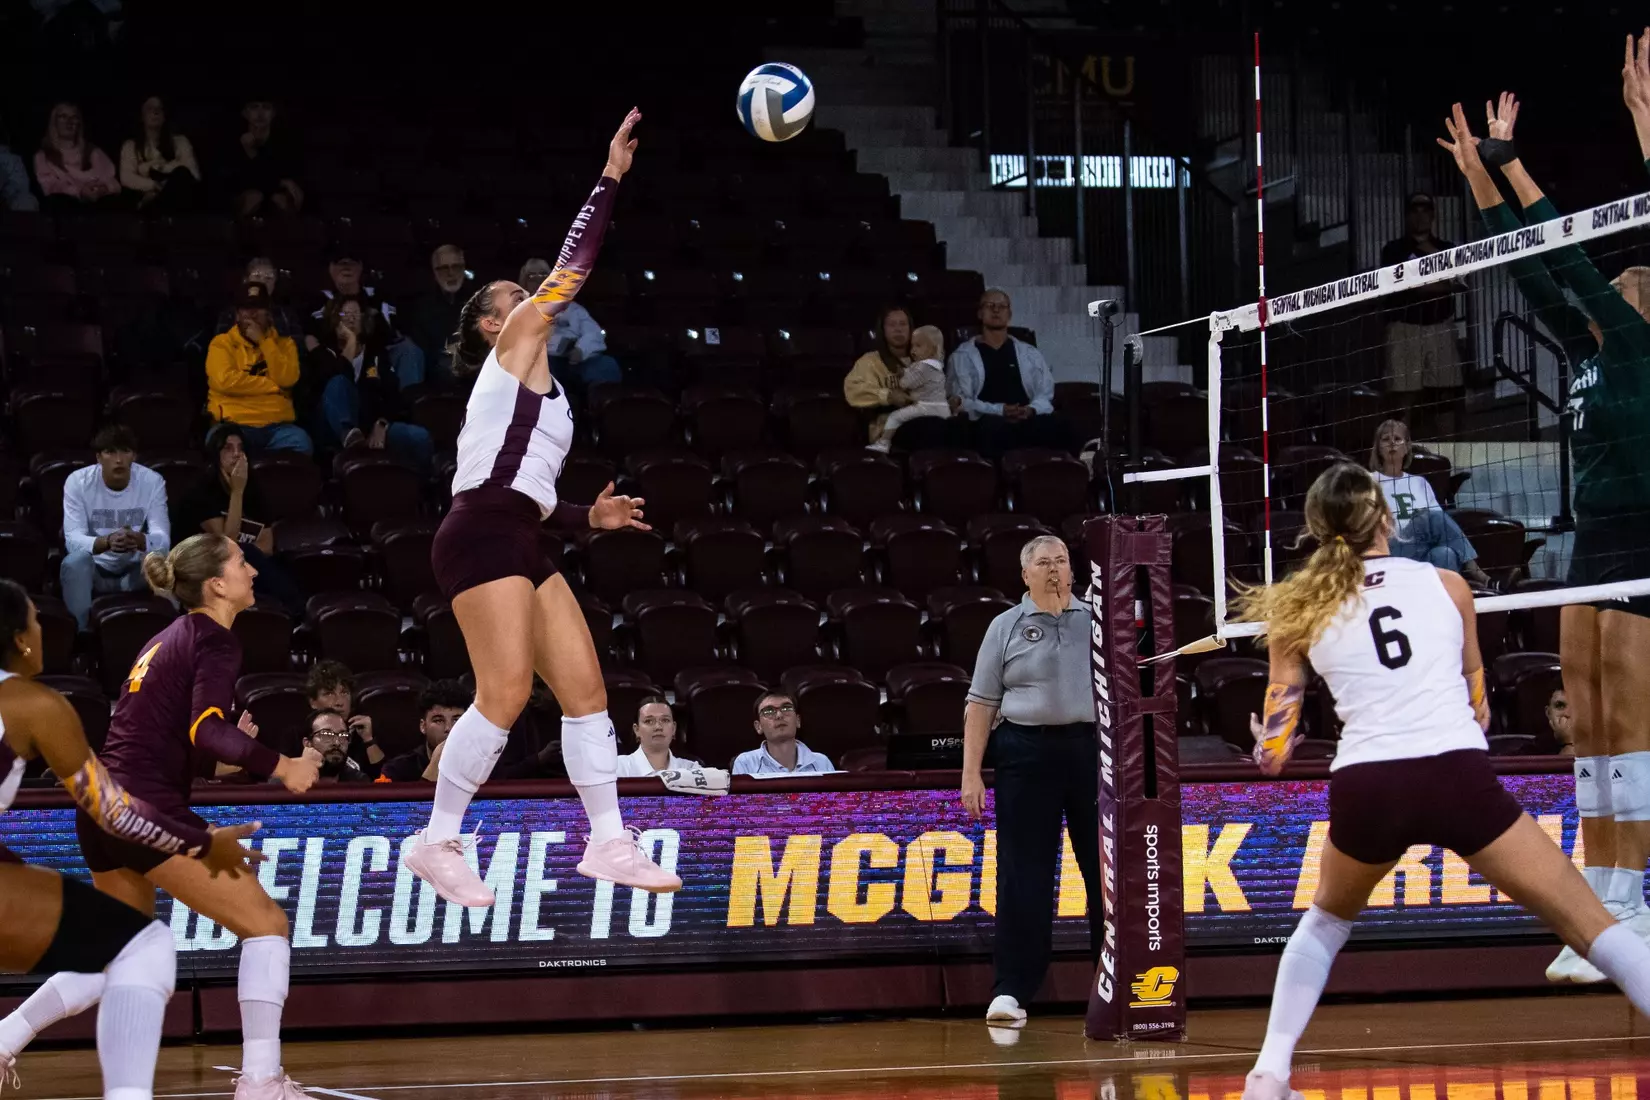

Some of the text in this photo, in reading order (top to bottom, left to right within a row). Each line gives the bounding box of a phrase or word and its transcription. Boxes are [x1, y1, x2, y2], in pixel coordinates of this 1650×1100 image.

[1592, 201, 1630, 230] CENTRAL
[1418, 225, 1546, 276] CENTRAL MICHIGAN VOLLEYBALL
[1272, 271, 1379, 316] CENTRAL MICHIGAN VOLLEYBALL
[1391, 493, 1416, 520] E
[1368, 605, 1413, 670] 6
[128, 641, 163, 693] 4
[1090, 560, 1116, 1004] CENTRAL MICHIGAN
[1143, 824, 1159, 880] sports
[1254, 936, 1291, 944] DAKTR
[538, 959, 607, 968] DAKTRONICS
[1149, 1022, 1175, 1030] 556-3198
